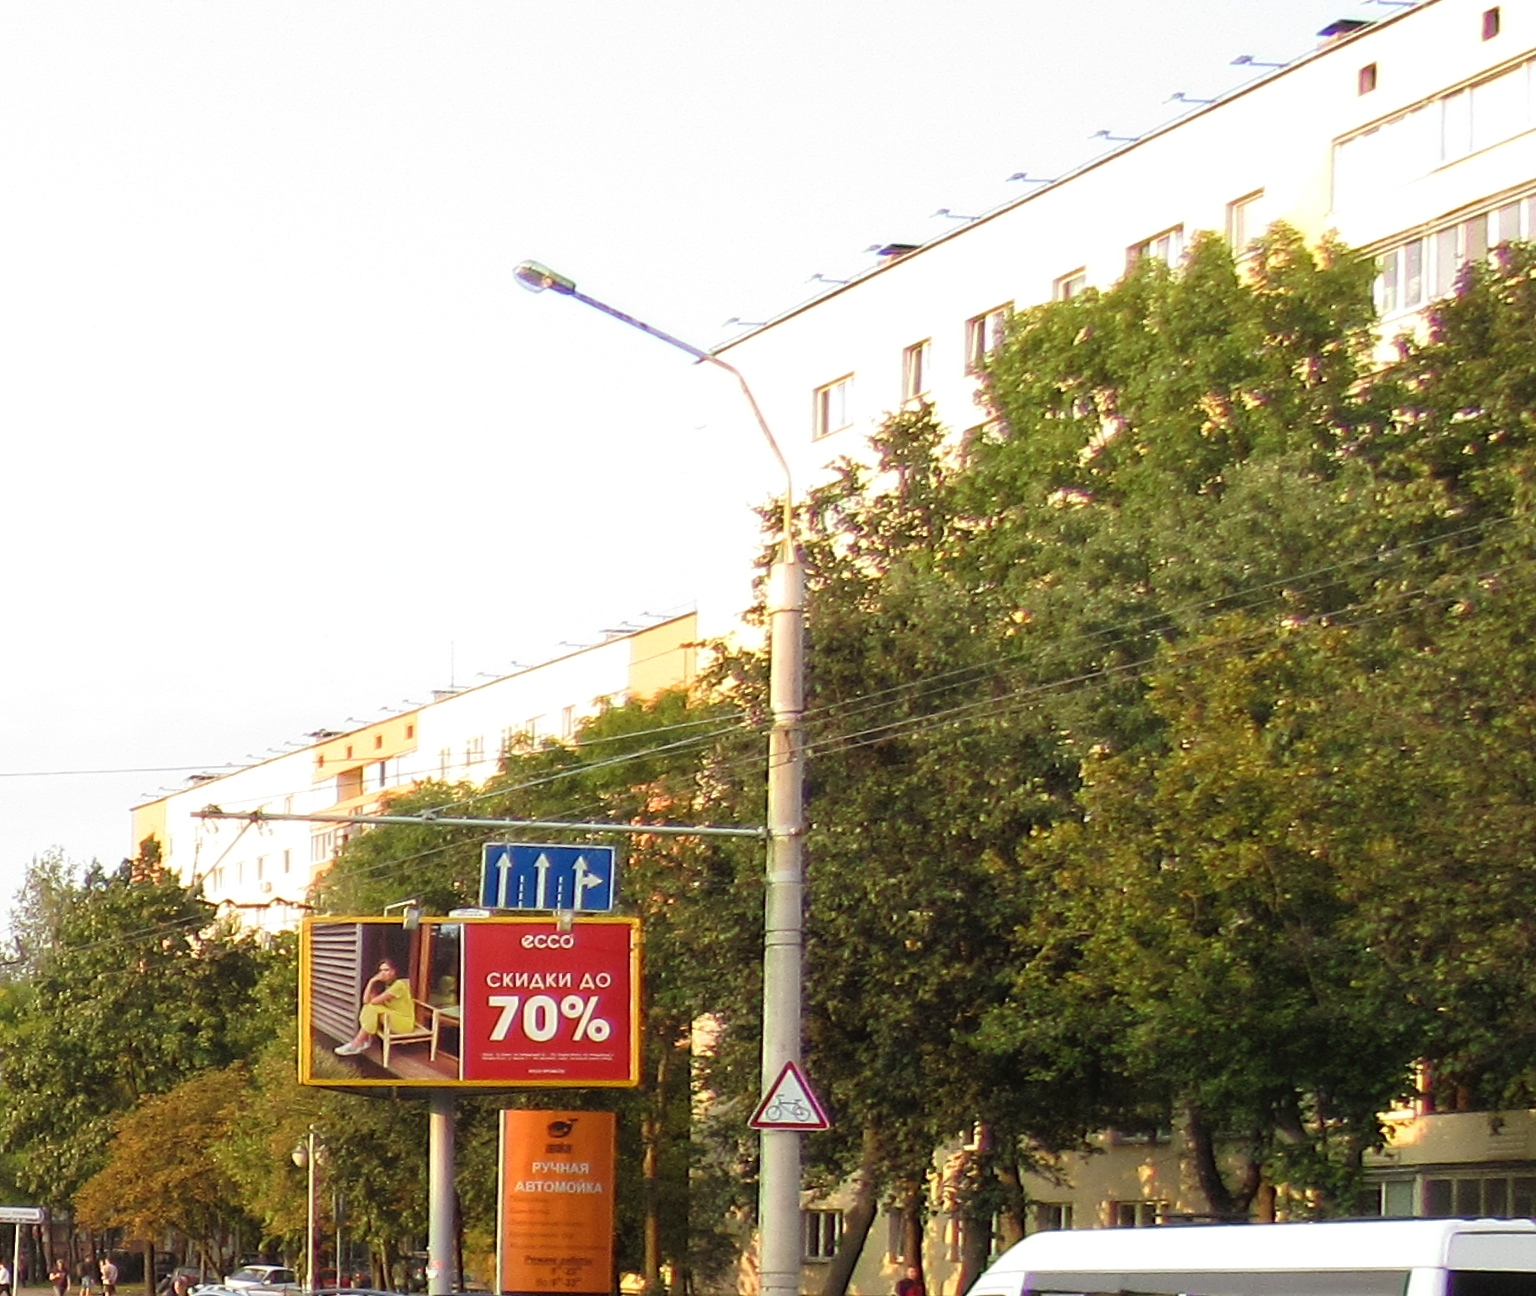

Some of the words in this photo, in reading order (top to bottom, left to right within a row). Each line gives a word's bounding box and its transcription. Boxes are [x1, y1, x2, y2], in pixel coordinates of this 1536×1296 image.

[521, 934, 574, 949] ecco
[486, 972, 572, 990] СКИДКИ
[579, 972, 611, 990] ДО
[487, 994, 611, 1042] 70%
[531, 1161, 590, 1175] РУЧНАЯ
[514, 1180, 603, 1194] АВТОМОЙКА
